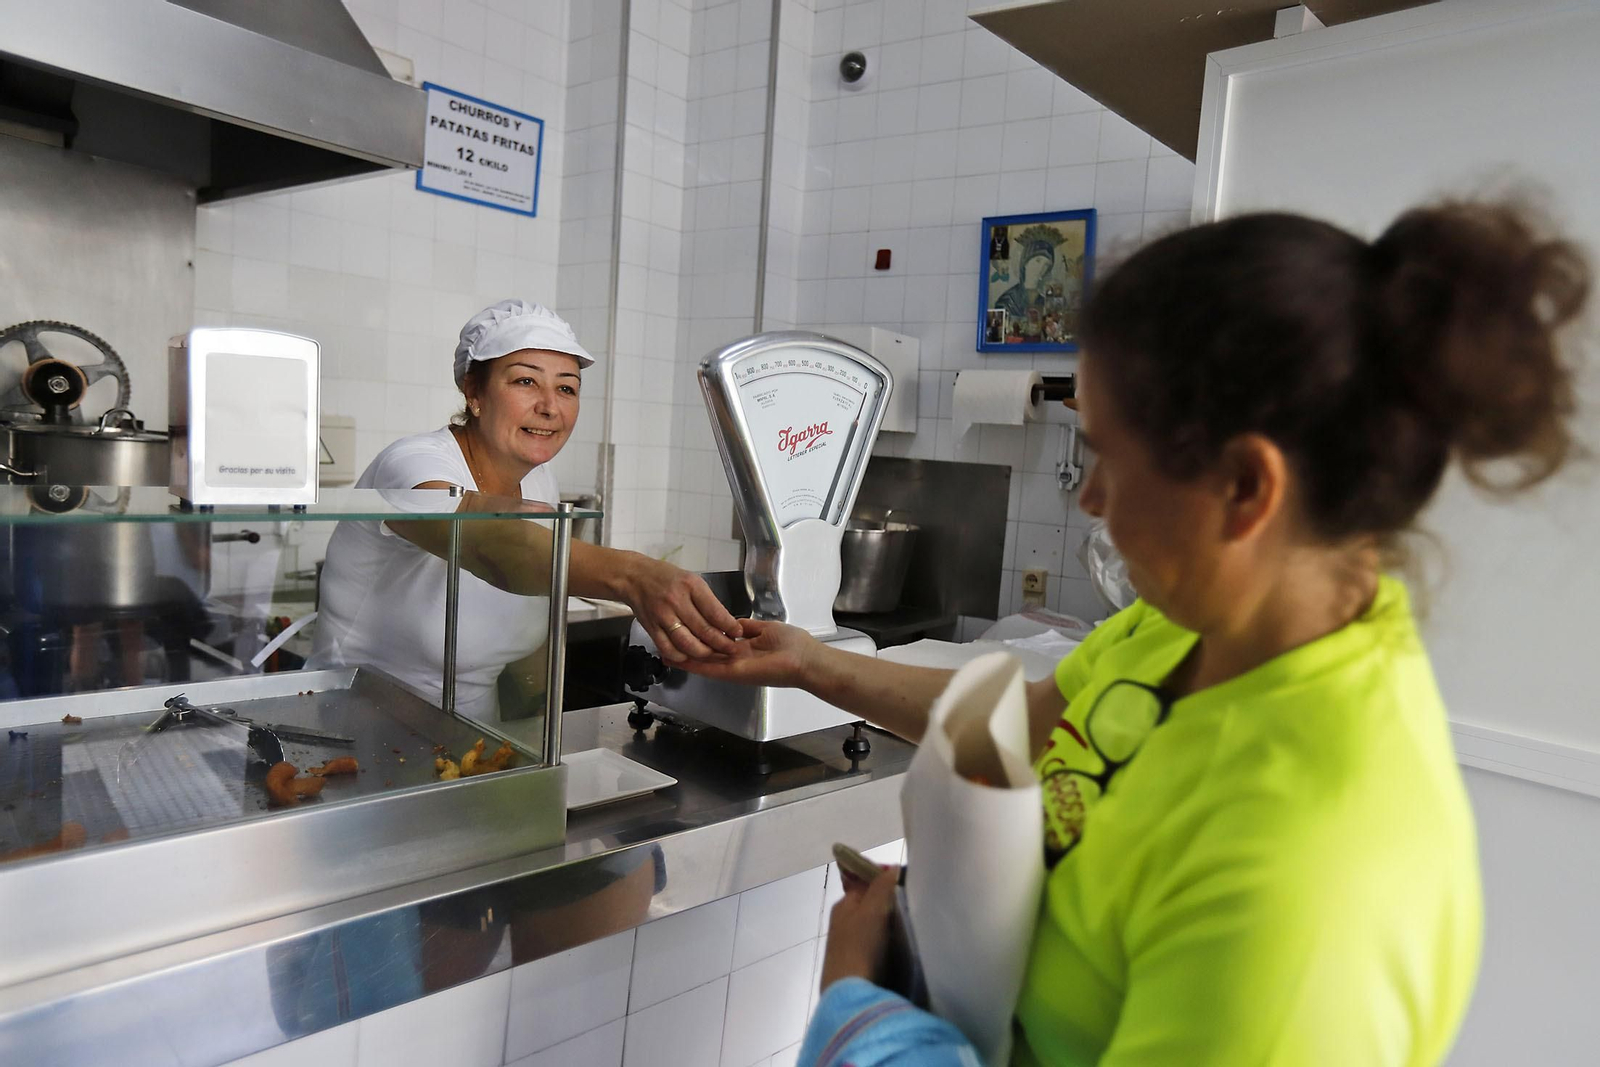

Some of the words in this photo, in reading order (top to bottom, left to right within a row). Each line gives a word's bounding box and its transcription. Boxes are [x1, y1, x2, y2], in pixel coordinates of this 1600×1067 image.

[449, 100, 509, 128] CHURROS
[514, 121, 521, 131] Y
[431, 115, 488, 142] PATATAS
[492, 134, 534, 156] FRITAS
[457, 147, 474, 162] 12
[778, 421, 833, 455] Igarra
[219, 465, 248, 474] Gracias
[250, 468, 263, 476] por
[276, 467, 296, 475] visita
